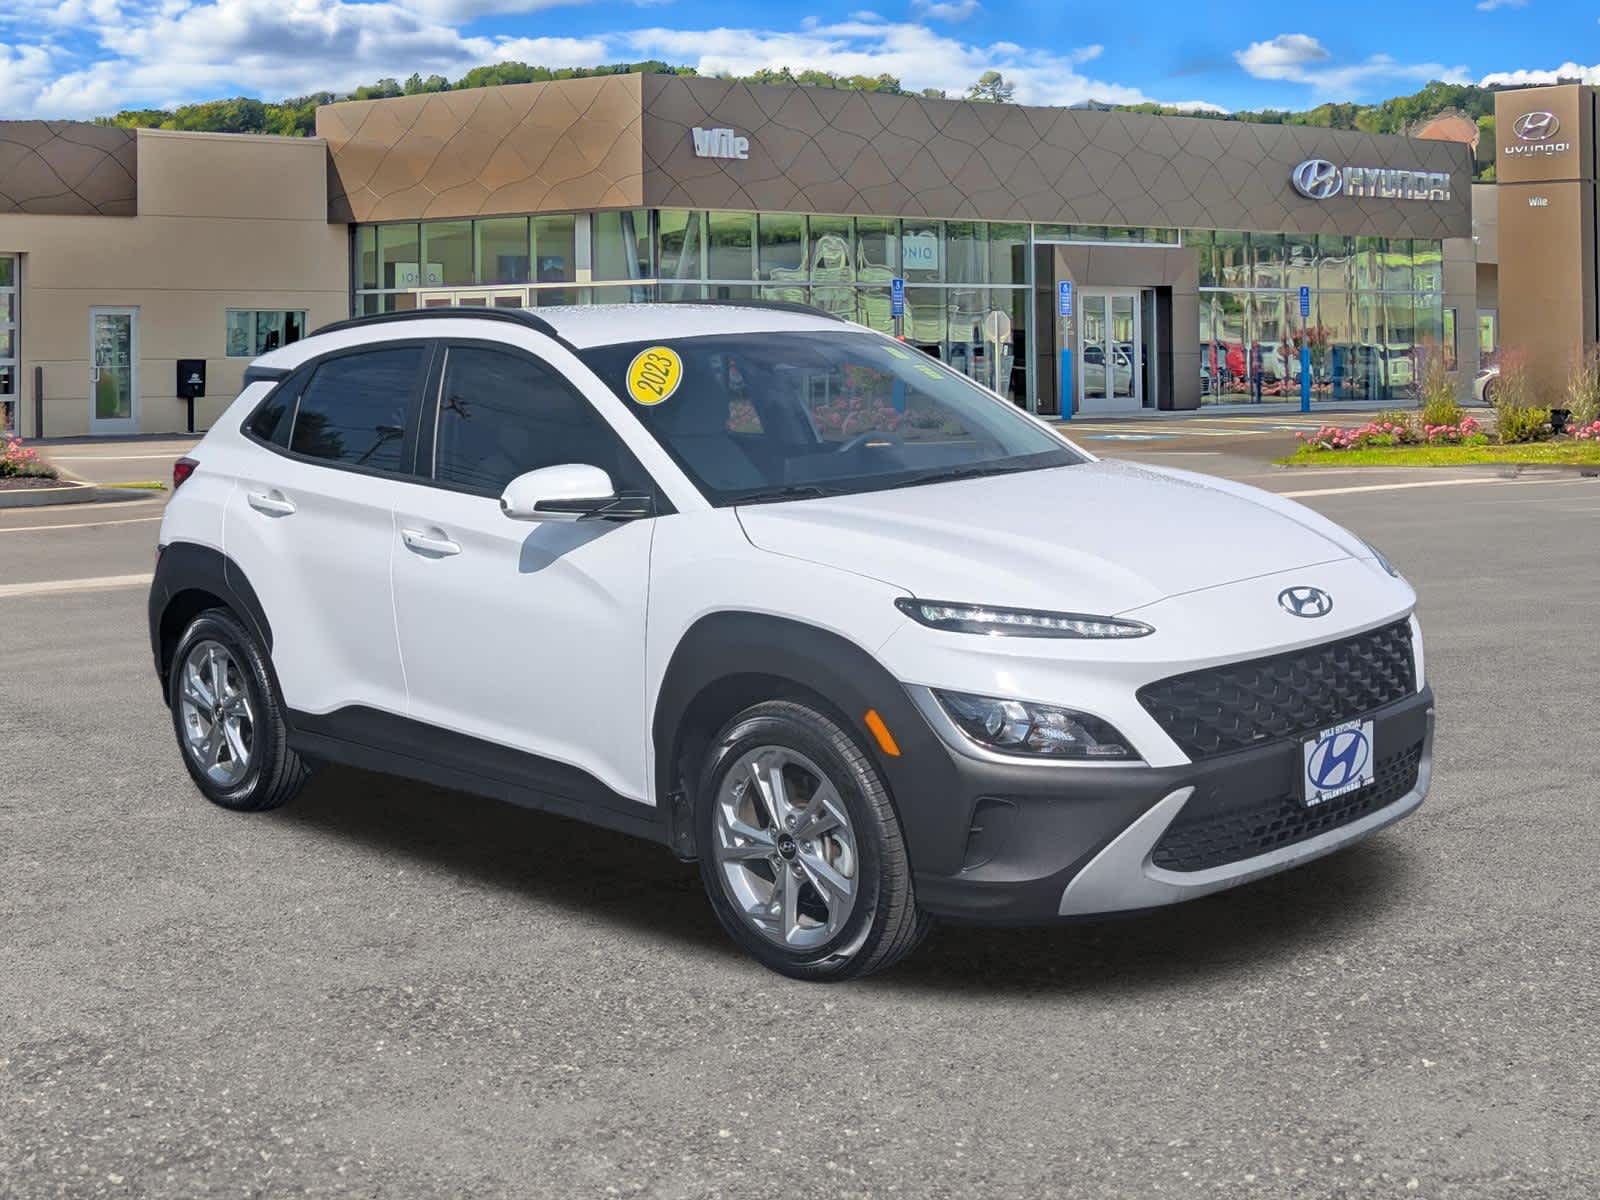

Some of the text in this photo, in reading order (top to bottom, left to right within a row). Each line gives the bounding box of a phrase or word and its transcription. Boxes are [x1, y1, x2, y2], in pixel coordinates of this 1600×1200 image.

[692, 126, 750, 160] Wile
[1342, 166, 1451, 201] HYUNDAI
[637, 353, 672, 396] 2023
